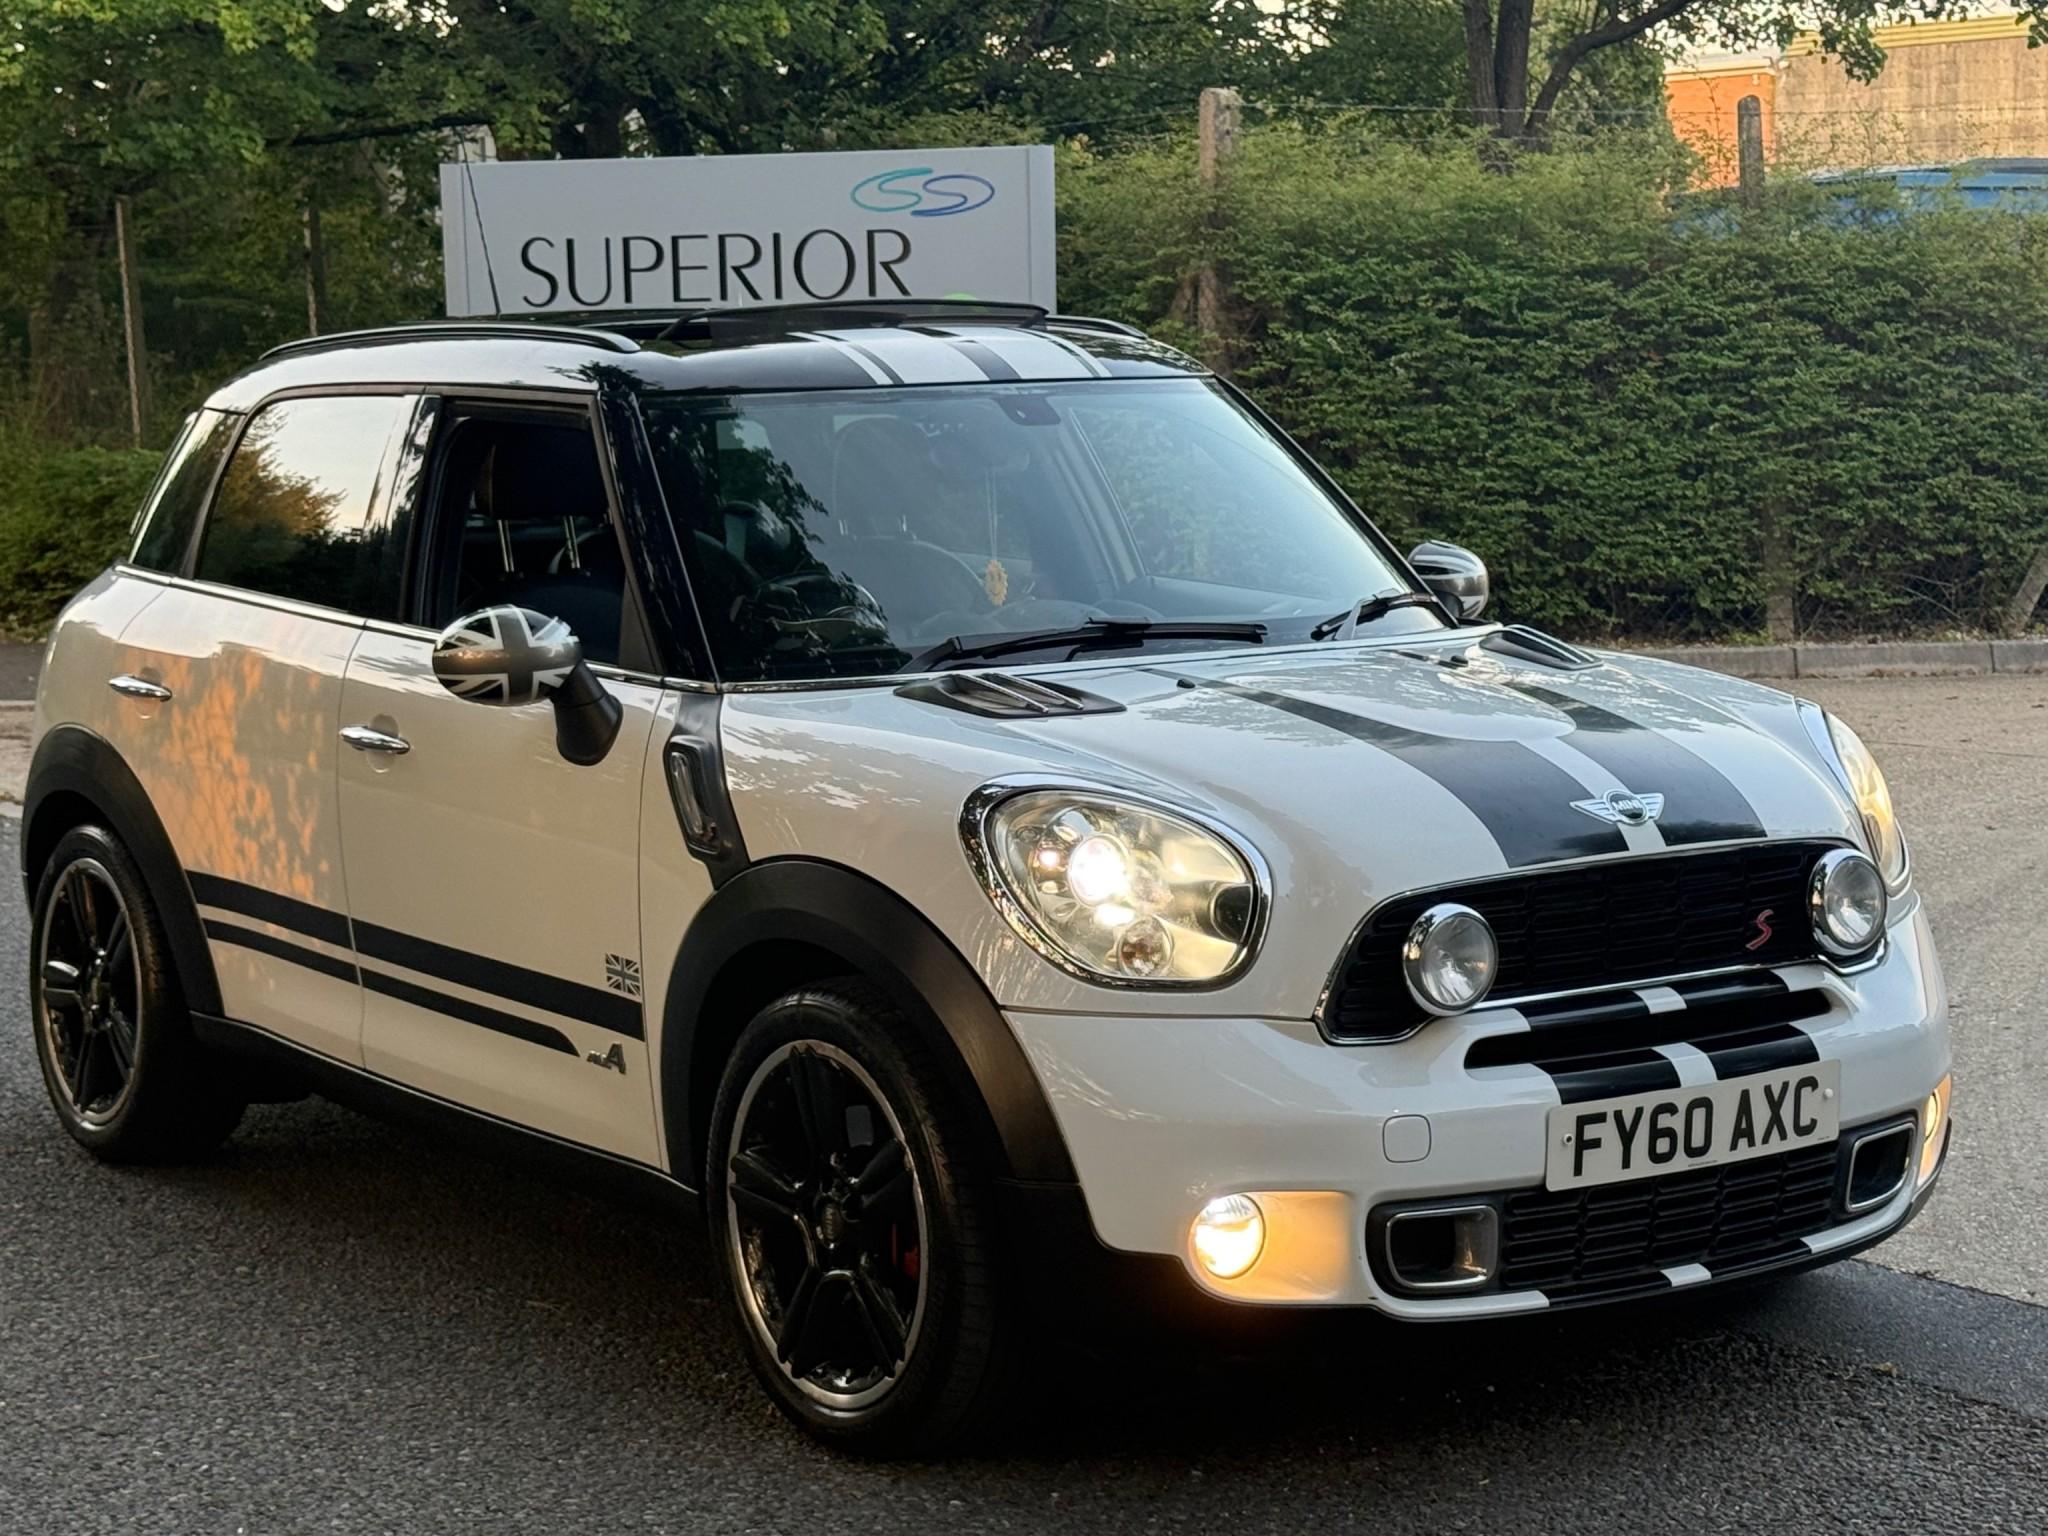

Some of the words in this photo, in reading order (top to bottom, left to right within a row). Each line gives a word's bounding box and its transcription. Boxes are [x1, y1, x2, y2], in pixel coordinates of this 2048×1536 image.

[519, 228, 913, 308] SUPERIOR
[1745, 908, 1775, 950] S
[1573, 1095, 1715, 1177] FY60
[1729, 1075, 1820, 1153] AXC
